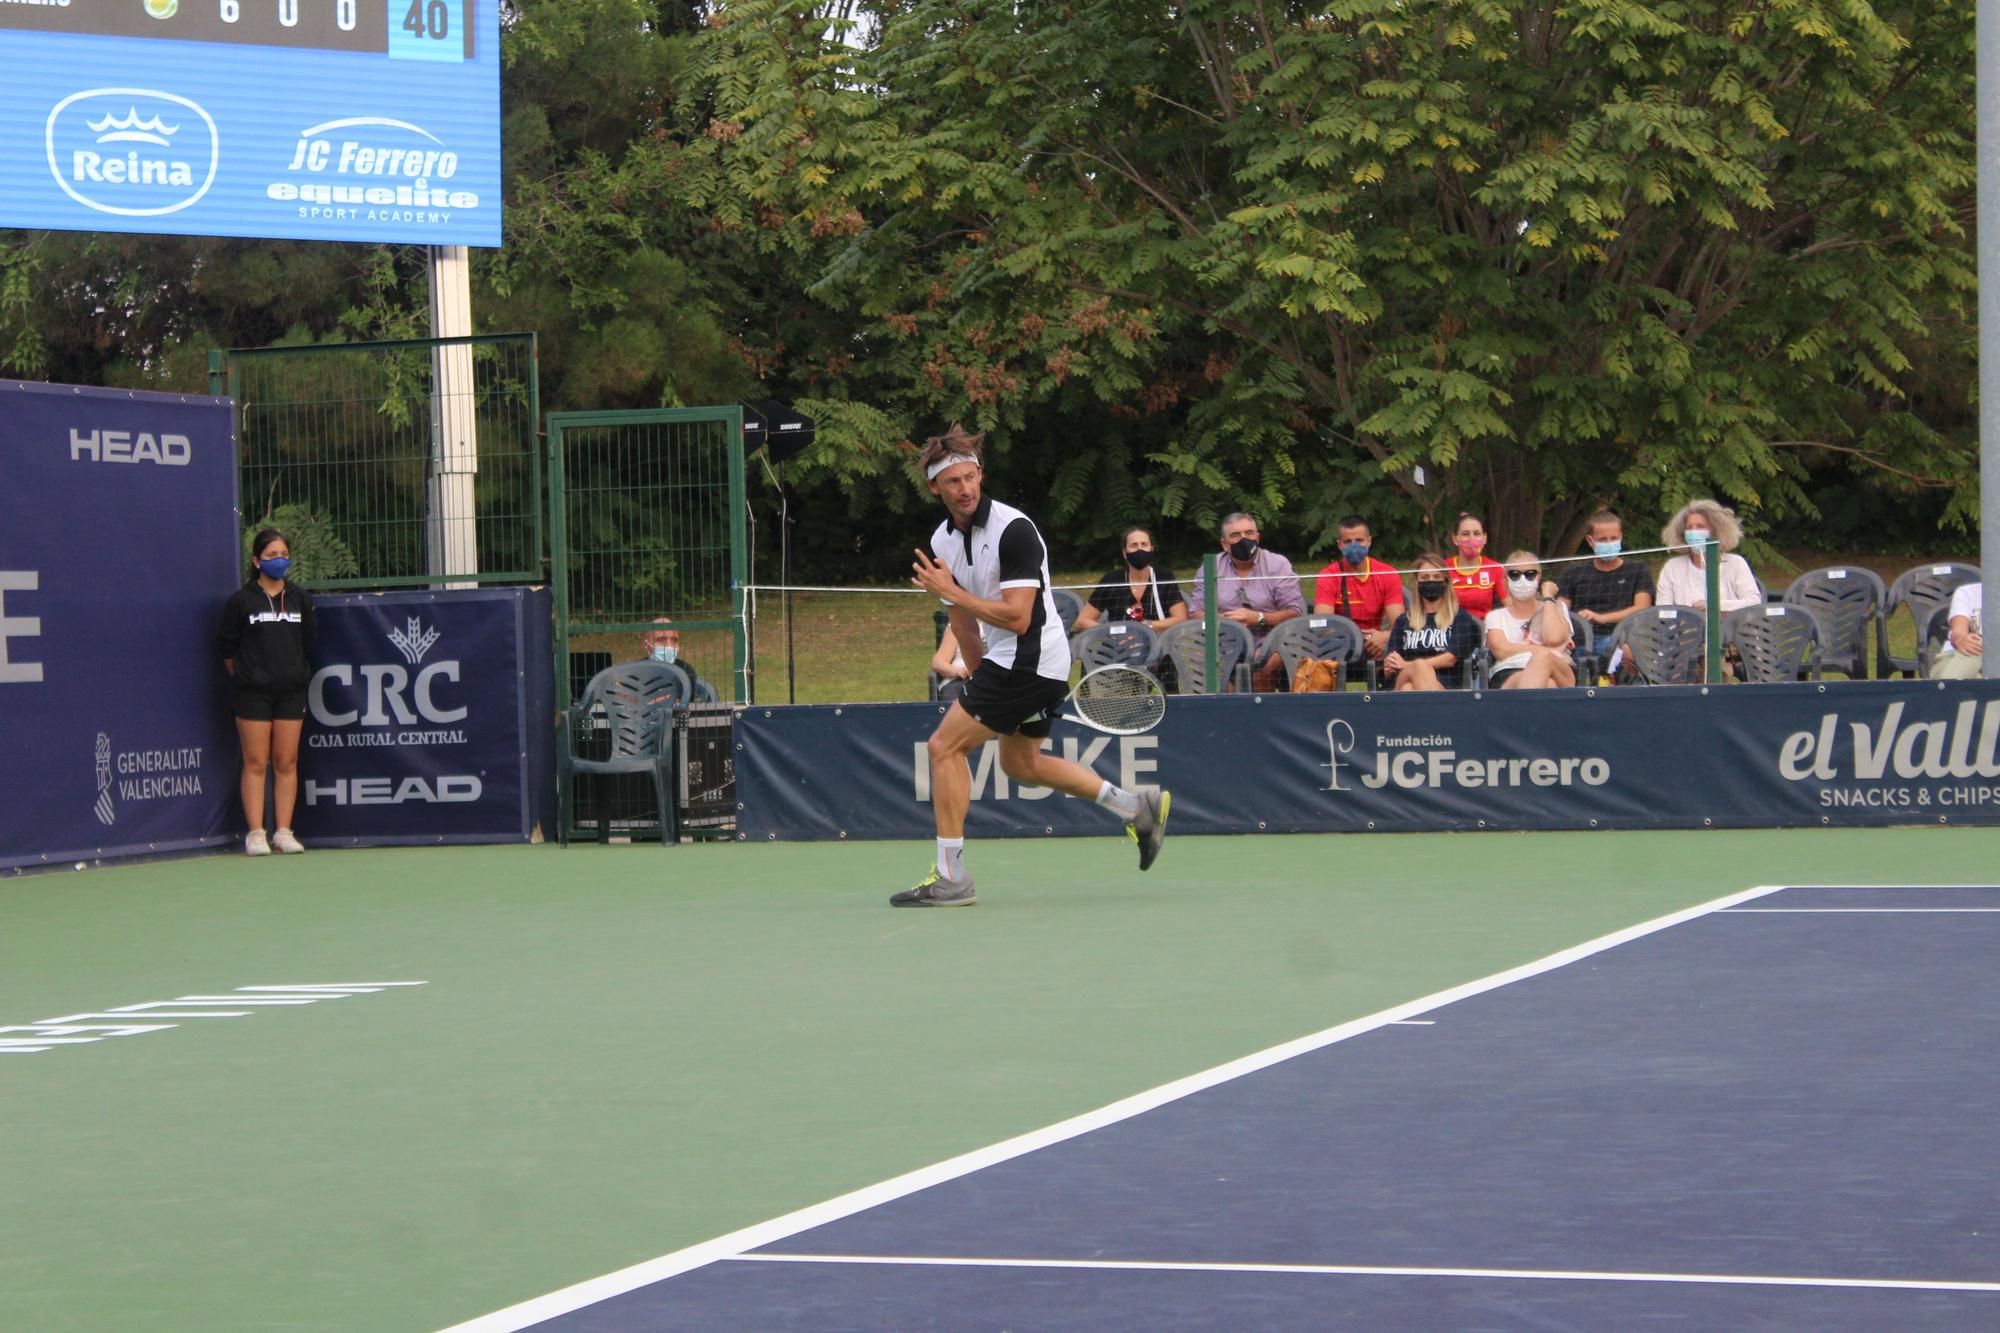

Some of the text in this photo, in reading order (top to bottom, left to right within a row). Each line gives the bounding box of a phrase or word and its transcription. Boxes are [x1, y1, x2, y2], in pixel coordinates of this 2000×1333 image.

[337, 0, 356, 31] 0
[403, 0, 449, 40] 40
[72, 150, 194, 187] Reina
[288, 139, 458, 179] JC Ferrero
[266, 178, 480, 209] equelite
[298, 207, 452, 224] SPORT ACADEMY
[70, 428, 192, 466] HEAD
[1402, 626, 1452, 651] MPORI
[308, 660, 468, 727] CRC
[308, 730, 468, 748] CAJA RURAL CENTRAL
[1376, 734, 1453, 747] Fundación
[1778, 713, 1839, 781] el
[117, 748, 203, 775] GENERALITAT
[1360, 750, 1612, 789] JCFerrero
[118, 775, 203, 801] VALENCIANA
[305, 775, 483, 806] HEAD
[1820, 788, 1911, 807] SNACKS
[1917, 787, 1932, 806] &
